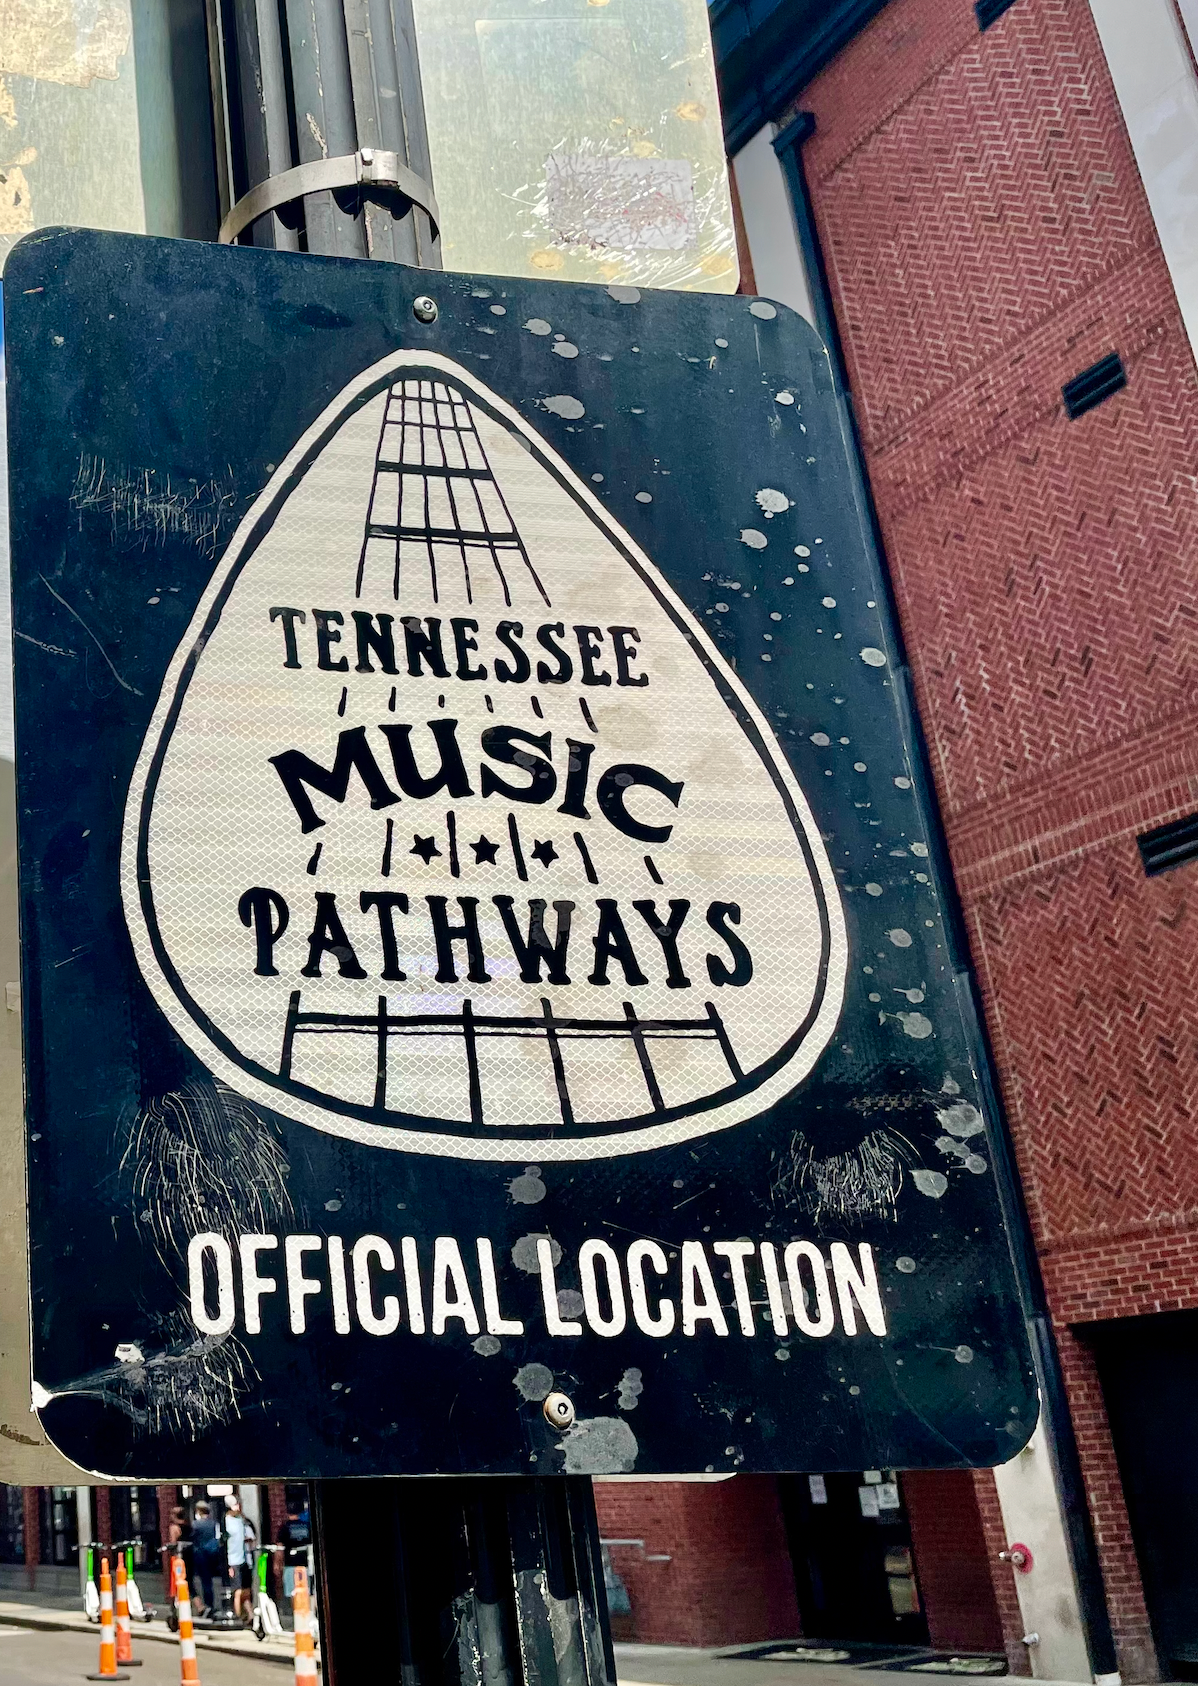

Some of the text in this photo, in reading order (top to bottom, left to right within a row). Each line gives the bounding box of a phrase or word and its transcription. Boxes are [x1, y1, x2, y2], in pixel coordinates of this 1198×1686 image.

[268, 606, 650, 686] TENNESSEE
[268, 718, 684, 843] MUSIC
[238, 887, 753, 988] PATHWAYS
[187, 1231, 888, 1339] OFFICIAL LOCATION
